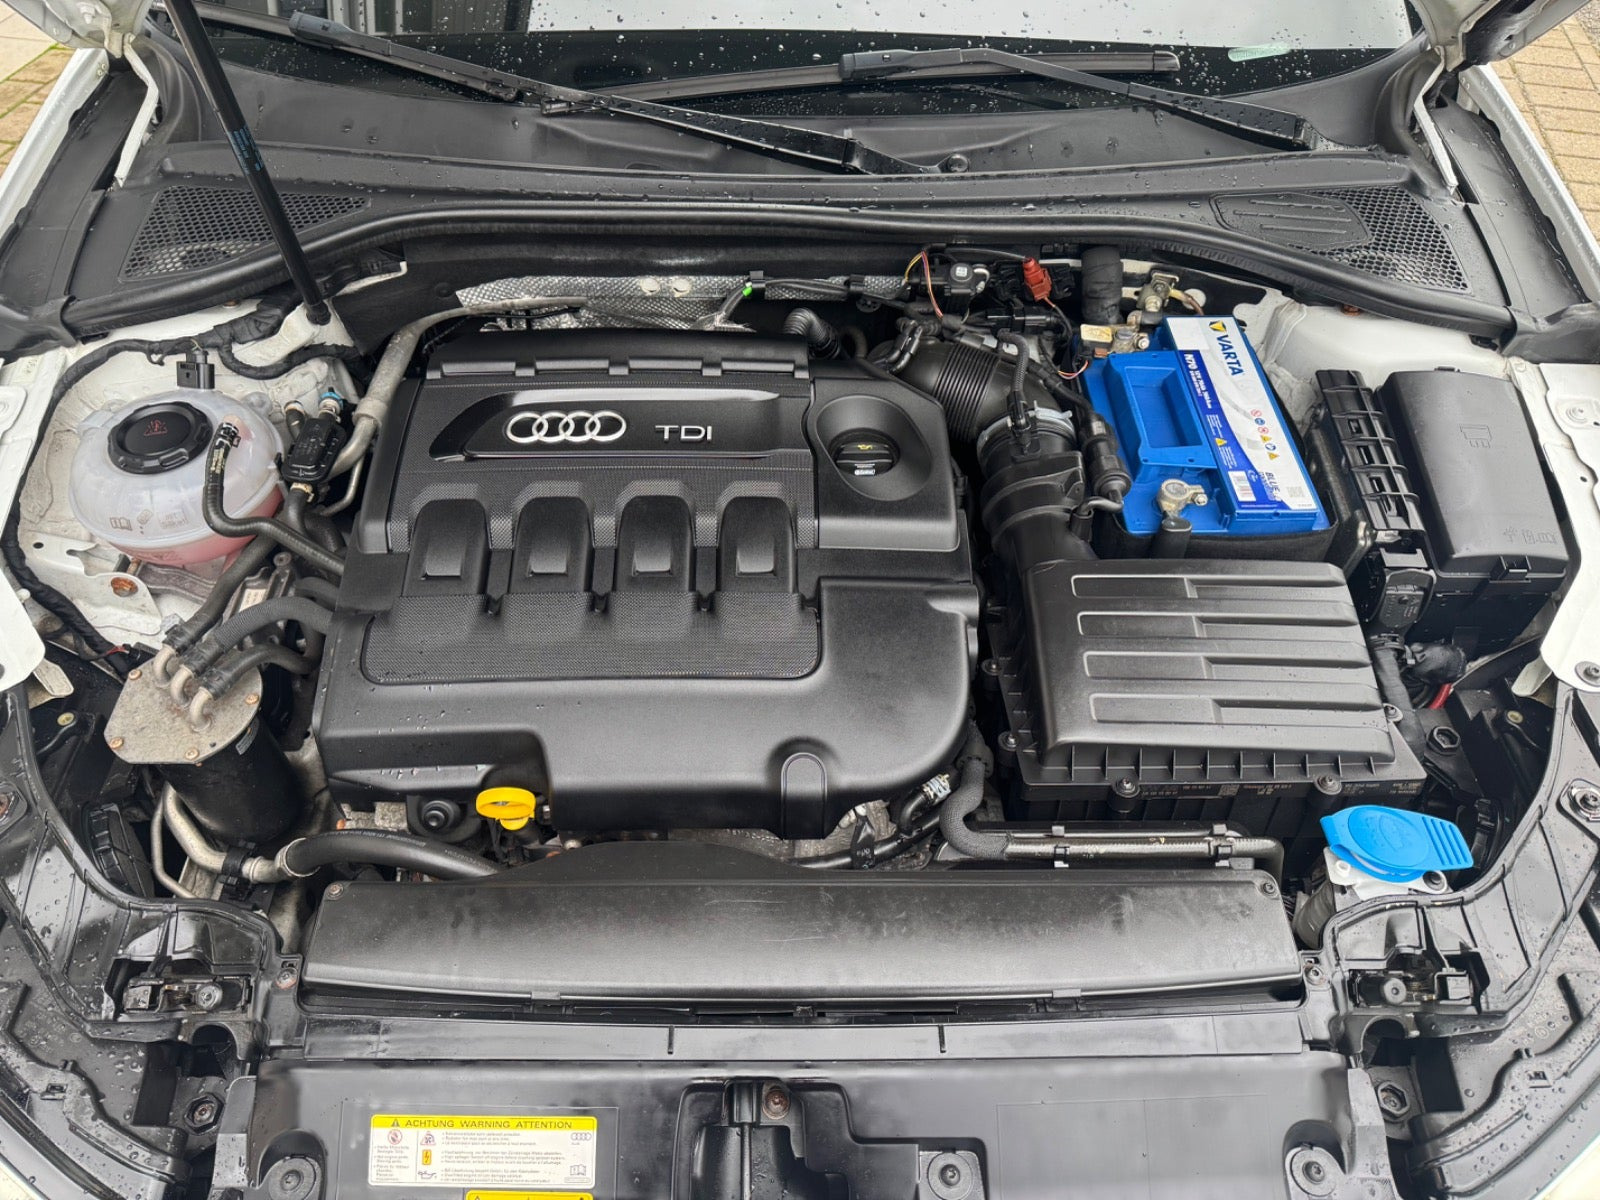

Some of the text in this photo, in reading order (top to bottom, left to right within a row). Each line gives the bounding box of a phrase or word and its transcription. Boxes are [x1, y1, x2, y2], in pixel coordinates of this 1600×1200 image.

[1183, 353, 1198, 370] N70
[1216, 334, 1245, 376] VARTA
[655, 425, 713, 440] TDI
[405, 1119, 573, 1129] ACHTUNG WARNING ATTENTION
